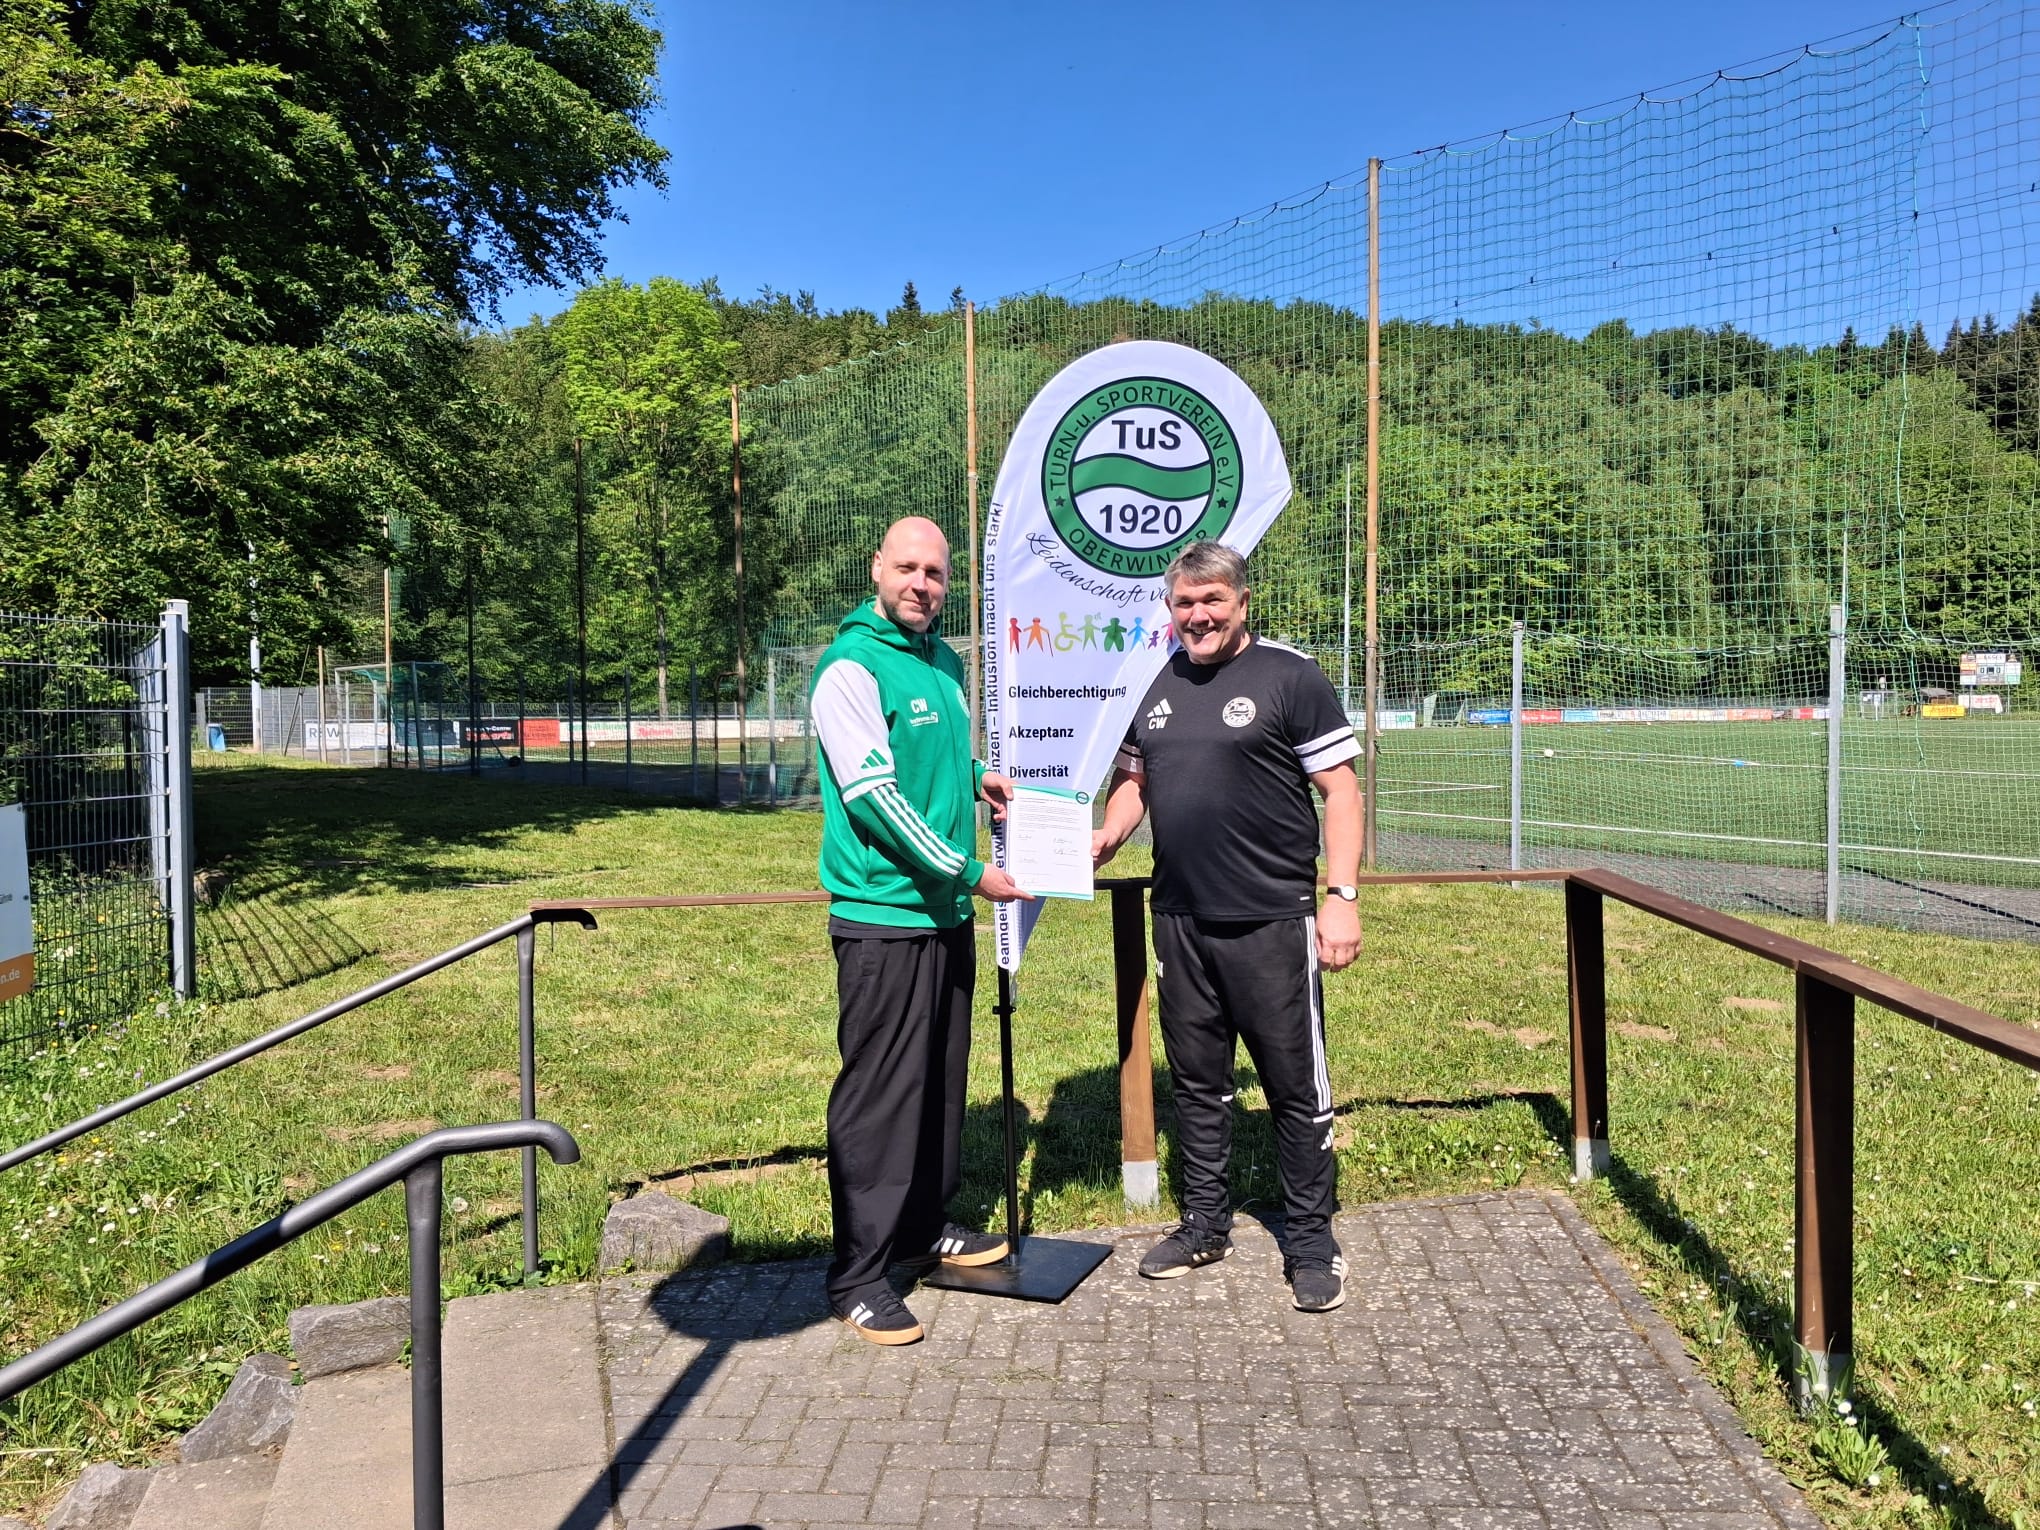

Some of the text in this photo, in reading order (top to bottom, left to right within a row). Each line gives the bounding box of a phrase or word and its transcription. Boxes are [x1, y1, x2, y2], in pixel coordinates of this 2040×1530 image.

[1096, 385, 1228, 451] SPORTVEREIN
[1216, 456, 1234, 492] e.V.
[1111, 419, 1182, 450] TuS
[987, 502, 1004, 546] stark!
[1099, 504, 1183, 535] 1920
[986, 555, 996, 581] uns
[1025, 532, 1147, 609] Leidenschaft
[985, 585, 996, 635] macht
[986, 641, 999, 712] Inklusion
[910, 698, 928, 714] CW
[1008, 685, 1127, 701] Gleichberechtigung
[1008, 725, 1075, 741] Akzeptanz
[1148, 716, 1169, 730] CW
[1009, 765, 1069, 778] Diversität
